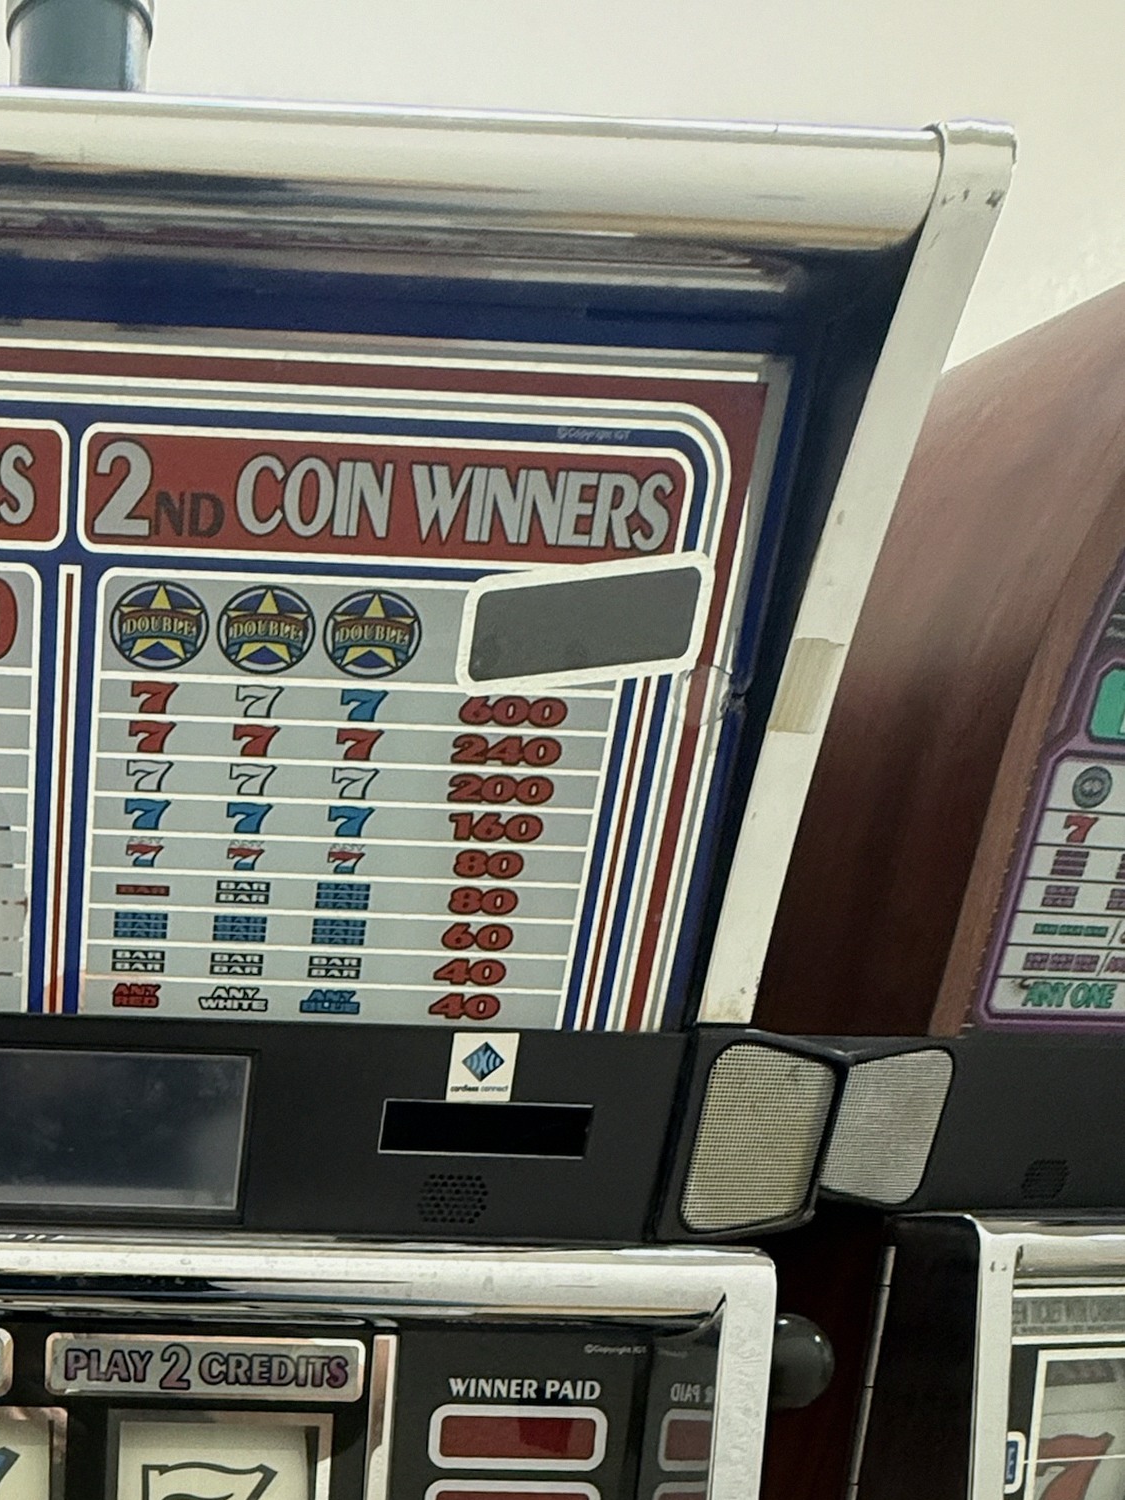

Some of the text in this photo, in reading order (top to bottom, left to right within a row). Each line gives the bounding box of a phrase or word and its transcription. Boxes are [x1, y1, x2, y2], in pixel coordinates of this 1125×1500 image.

[235, 453, 393, 540] COIN
[411, 462, 673, 553] WINNERS
[124, 614, 199, 637] DOUBLE
[231, 618, 304, 641] DOUBLE
[337, 622, 409, 645] DOUBLE
[130, 680, 568, 728] 7 7 7 600
[451, 733, 562, 767] 240
[446, 772, 554, 805] 200
[448, 812, 544, 843] 160
[453, 849, 525, 879] 80
[448, 886, 519, 916] 80
[440, 921, 514, 952] 60
[432, 958, 507, 986] 40
[427, 993, 501, 1020] 40
[1069, 982, 1118, 1009] ONE
[64, 1343, 350, 1391] PLAY 2 CREDITS
[449, 1377, 601, 1400] WINNER PAID
